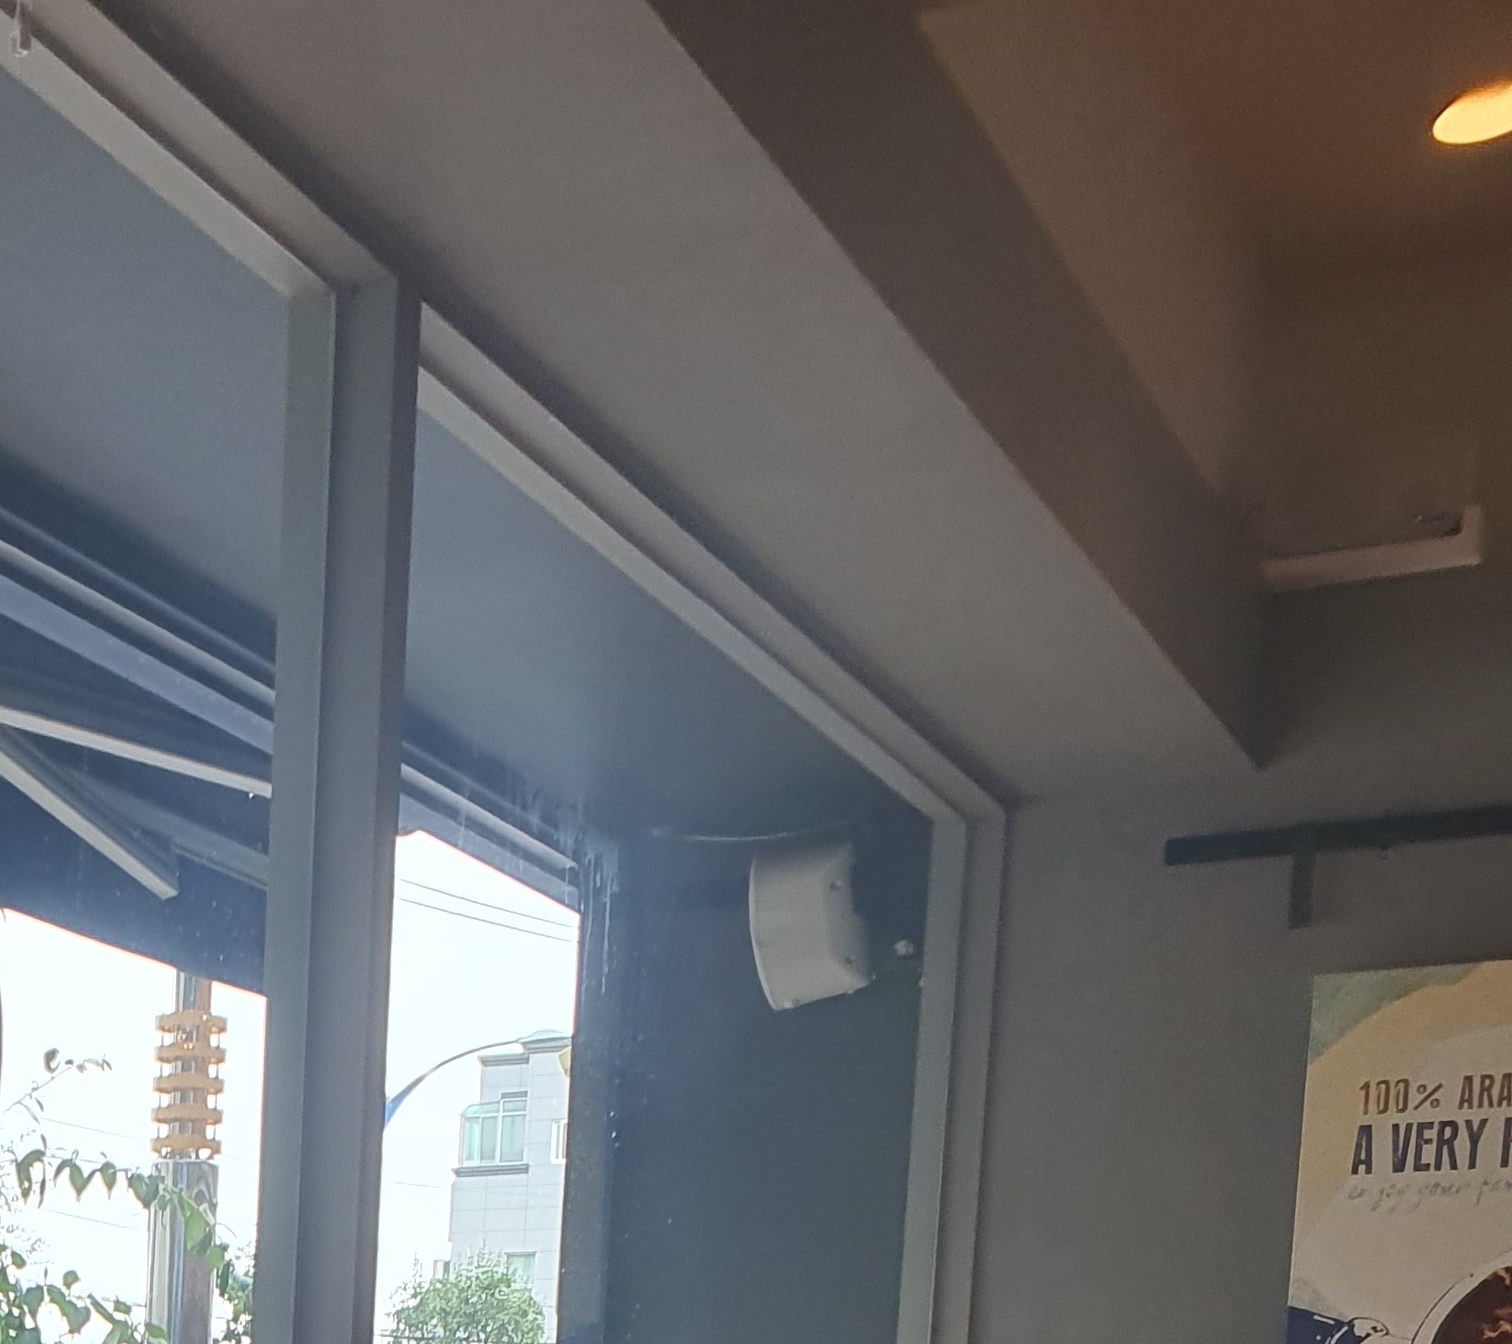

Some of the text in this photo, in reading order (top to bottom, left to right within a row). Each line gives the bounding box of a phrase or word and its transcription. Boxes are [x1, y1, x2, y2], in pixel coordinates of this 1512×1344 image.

[1359, 1078, 1444, 1115] 100%
[1351, 1124, 1373, 1175] A
[1391, 1117, 1489, 1174] VERY
